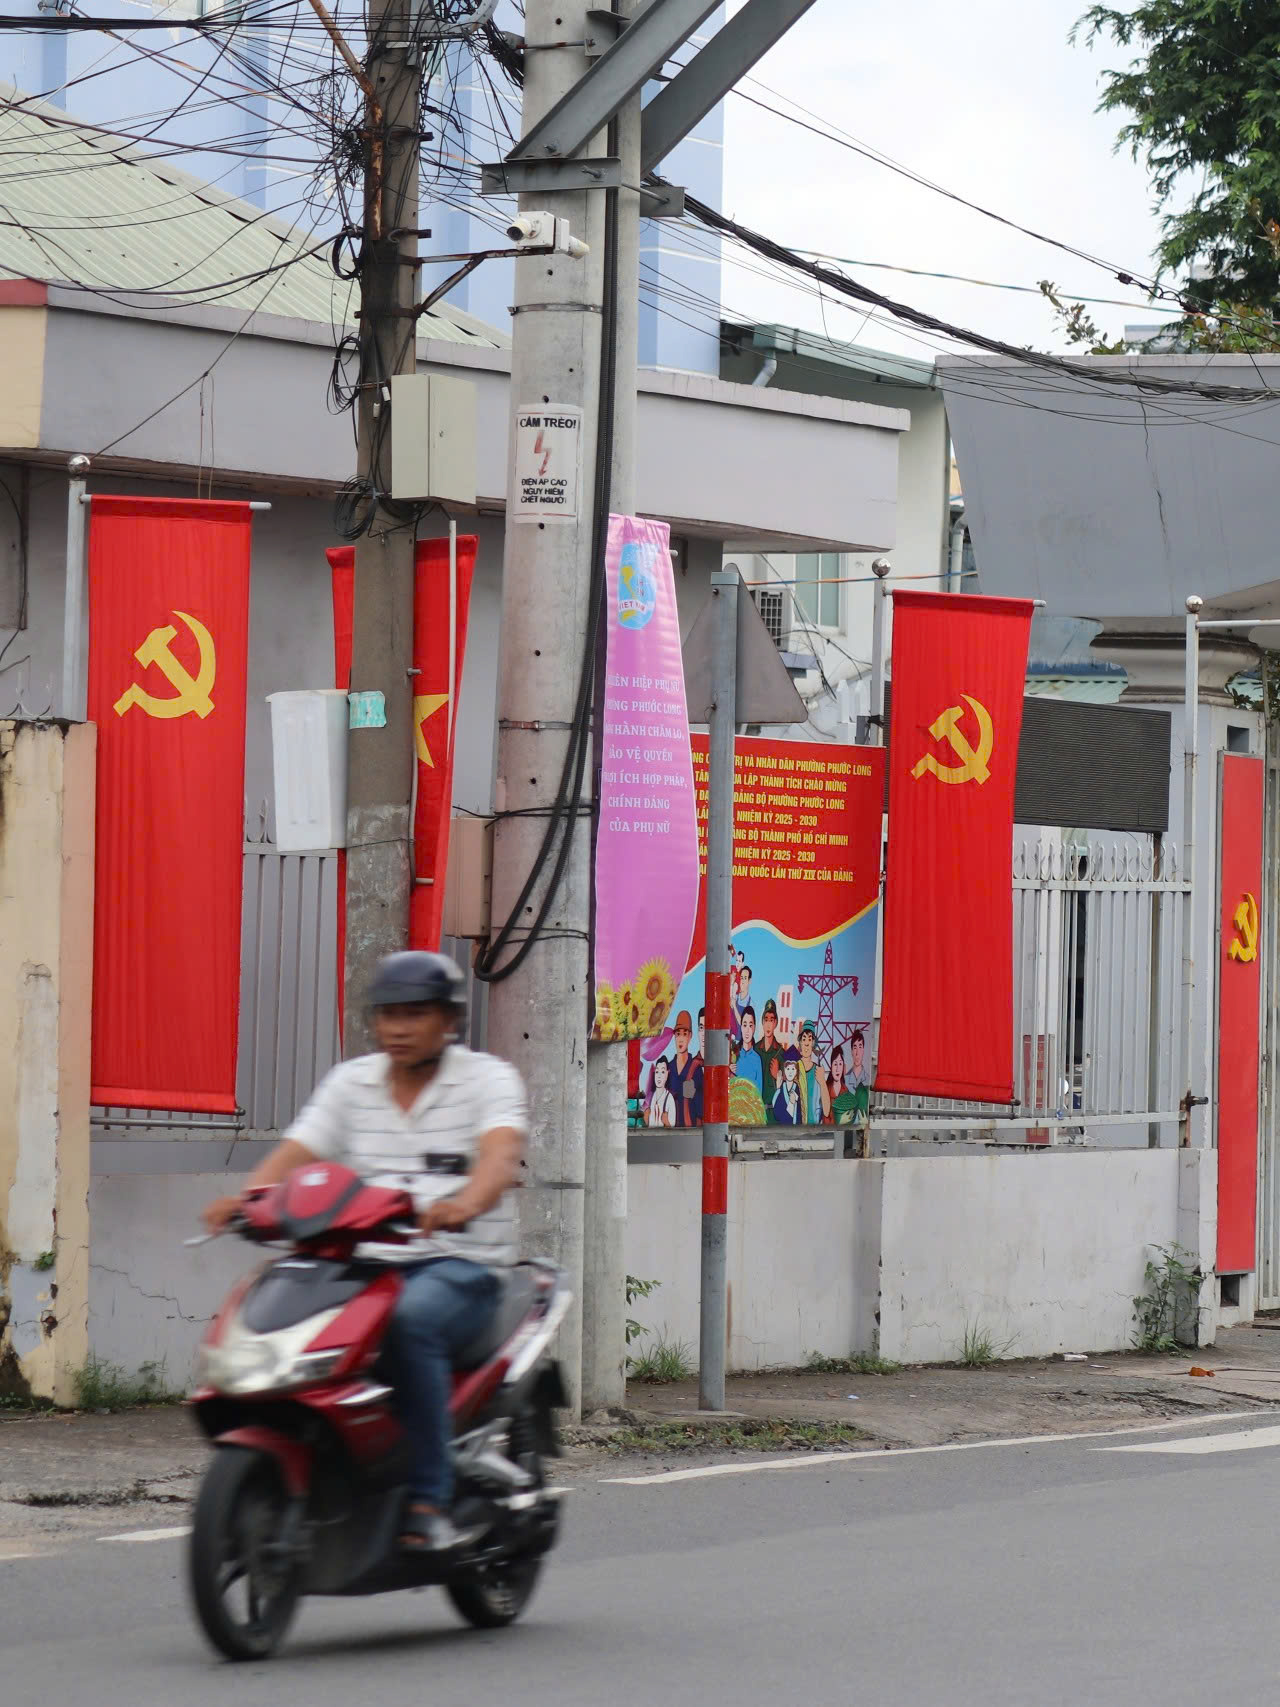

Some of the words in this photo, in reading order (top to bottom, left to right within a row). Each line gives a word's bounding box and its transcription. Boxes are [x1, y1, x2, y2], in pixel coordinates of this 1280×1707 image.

[615, 721, 646, 736] HÀNH
[608, 744, 623, 759] ẢO
[626, 746, 641, 763] VỆ
[734, 755, 742, 768] RỊ
[745, 754, 754, 767] VÀ
[756, 756, 777, 769] NHÂN
[779, 758, 794, 770] DÂN
[796, 759, 825, 772] PHƯỜNG
[827, 762, 851, 775] PHƯỚC
[853, 765, 872, 776] LONG
[744, 773, 758, 787] LẬP
[760, 774, 784, 787] THÀNH
[786, 776, 802, 789] TÍCH
[804, 778, 823, 790] CHÀO
[825, 779, 846, 792] MỪNG
[608, 794, 640, 808] CHÍNH
[756, 792, 766, 807] BỘ
[768, 793, 798, 807] PHƯỜNG
[800, 796, 824, 808] PHƯỚC
[826, 799, 844, 810] LONG
[610, 817, 630, 832] CỦA
[634, 822, 654, 836] PHỤ
[657, 821, 670, 833] NỮ
[737, 809, 761, 824] NHIỆM
[764, 811, 773, 823] KỲ
[775, 814, 792, 824] 2025
[800, 815, 817, 826] 2030
[733, 825, 746, 840] ẢNG
[749, 828, 758, 843] BỘ
[761, 829, 784, 842] THÀNH
[829, 835, 848, 846] MINH
[736, 846, 759, 861] NHIỆM
[762, 847, 771, 860] KỲ
[773, 850, 791, 861] 2025
[798, 851, 815, 862] 2030
[733, 864, 747, 876] OÀN
[750, 863, 769, 878] QUỐC
[788, 867, 802, 879] THỨ
[803, 869, 816, 880] XIV
[817, 867, 831, 880] CỦA
[834, 868, 853, 882] ĐẢNG
